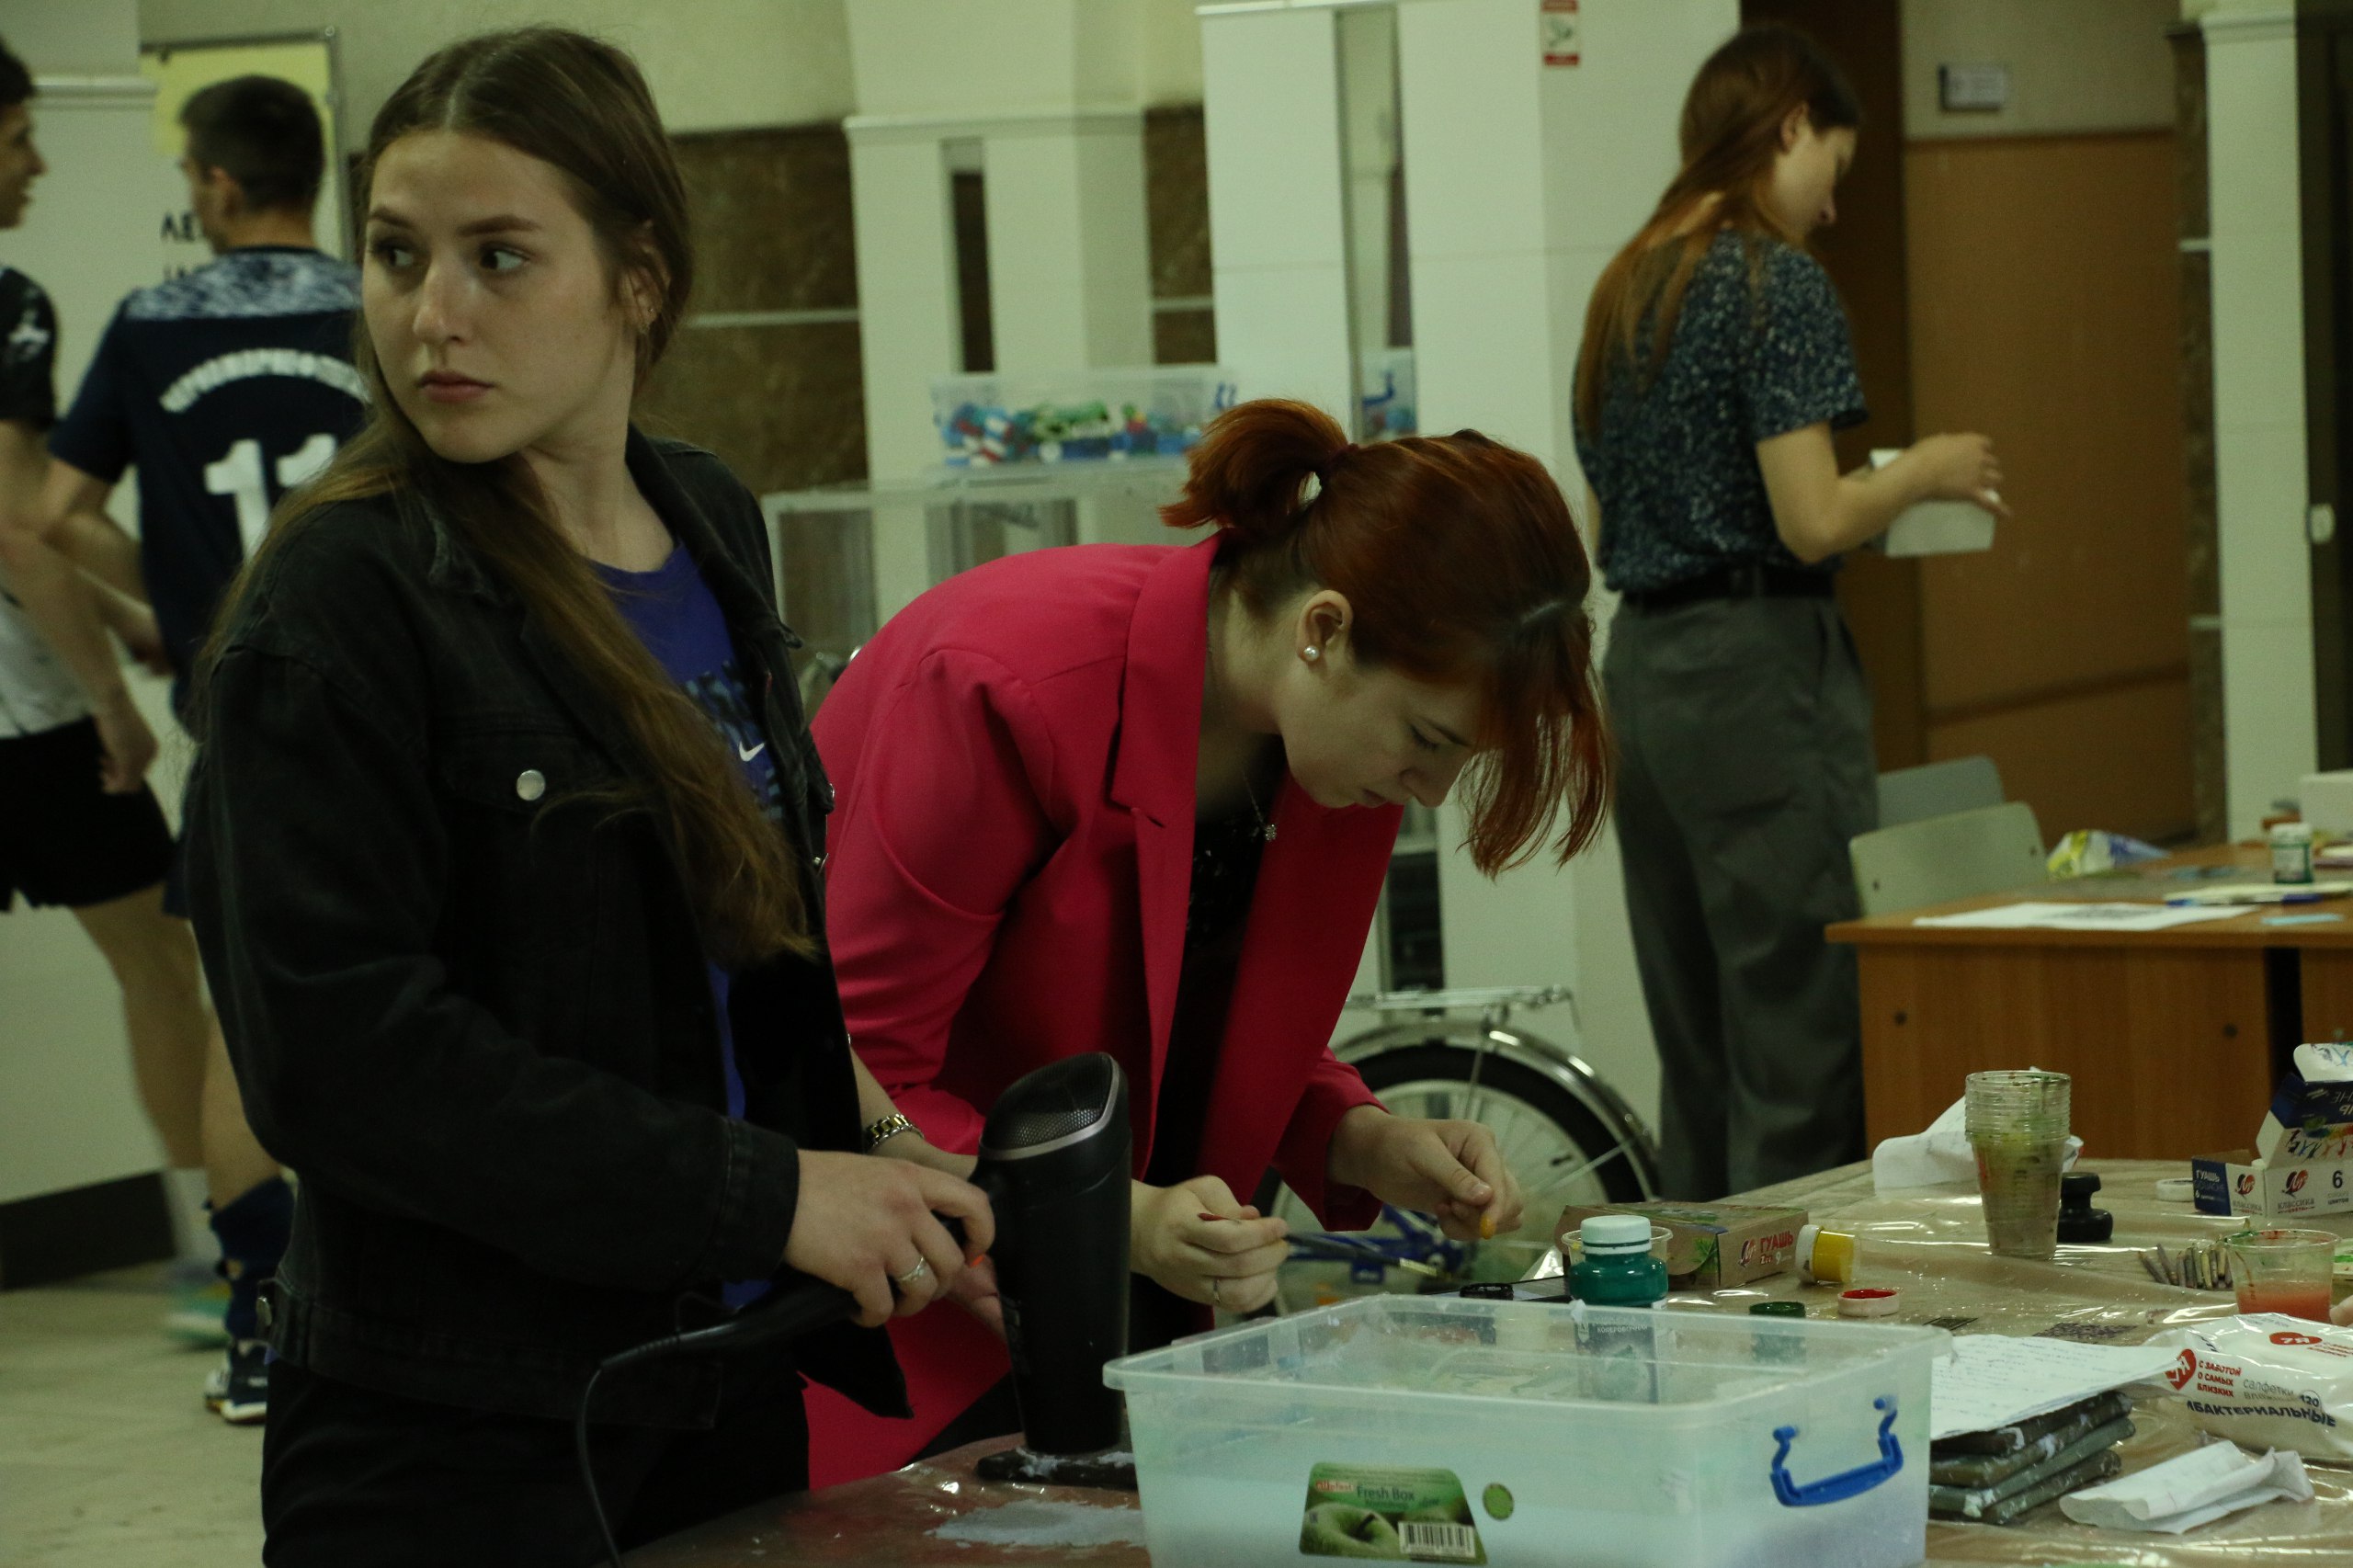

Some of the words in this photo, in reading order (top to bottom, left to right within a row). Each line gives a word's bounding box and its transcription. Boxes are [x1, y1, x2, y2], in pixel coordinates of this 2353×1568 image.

[2332, 1170, 2343, 1188] 6
[2278, 1198, 2315, 1210] КЛАССИКА
[1759, 1230, 1795, 1253] ГУАШЬ
[1775, 1251, 1782, 1266] 9
[2199, 1360, 2204, 1369] С
[2204, 1361, 2242, 1377] ЗАБОТОЙ
[2198, 1371, 2203, 1380] О
[2204, 1373, 2234, 1387] САМЫХ
[2198, 1383, 2234, 1398] БЛИЗКИХ
[2243, 1379, 2294, 1396] салфетки
[2300, 1394, 2320, 1408] 120
[1357, 1484, 1390, 1499] Fresh
[1392, 1486, 1415, 1502] Box
